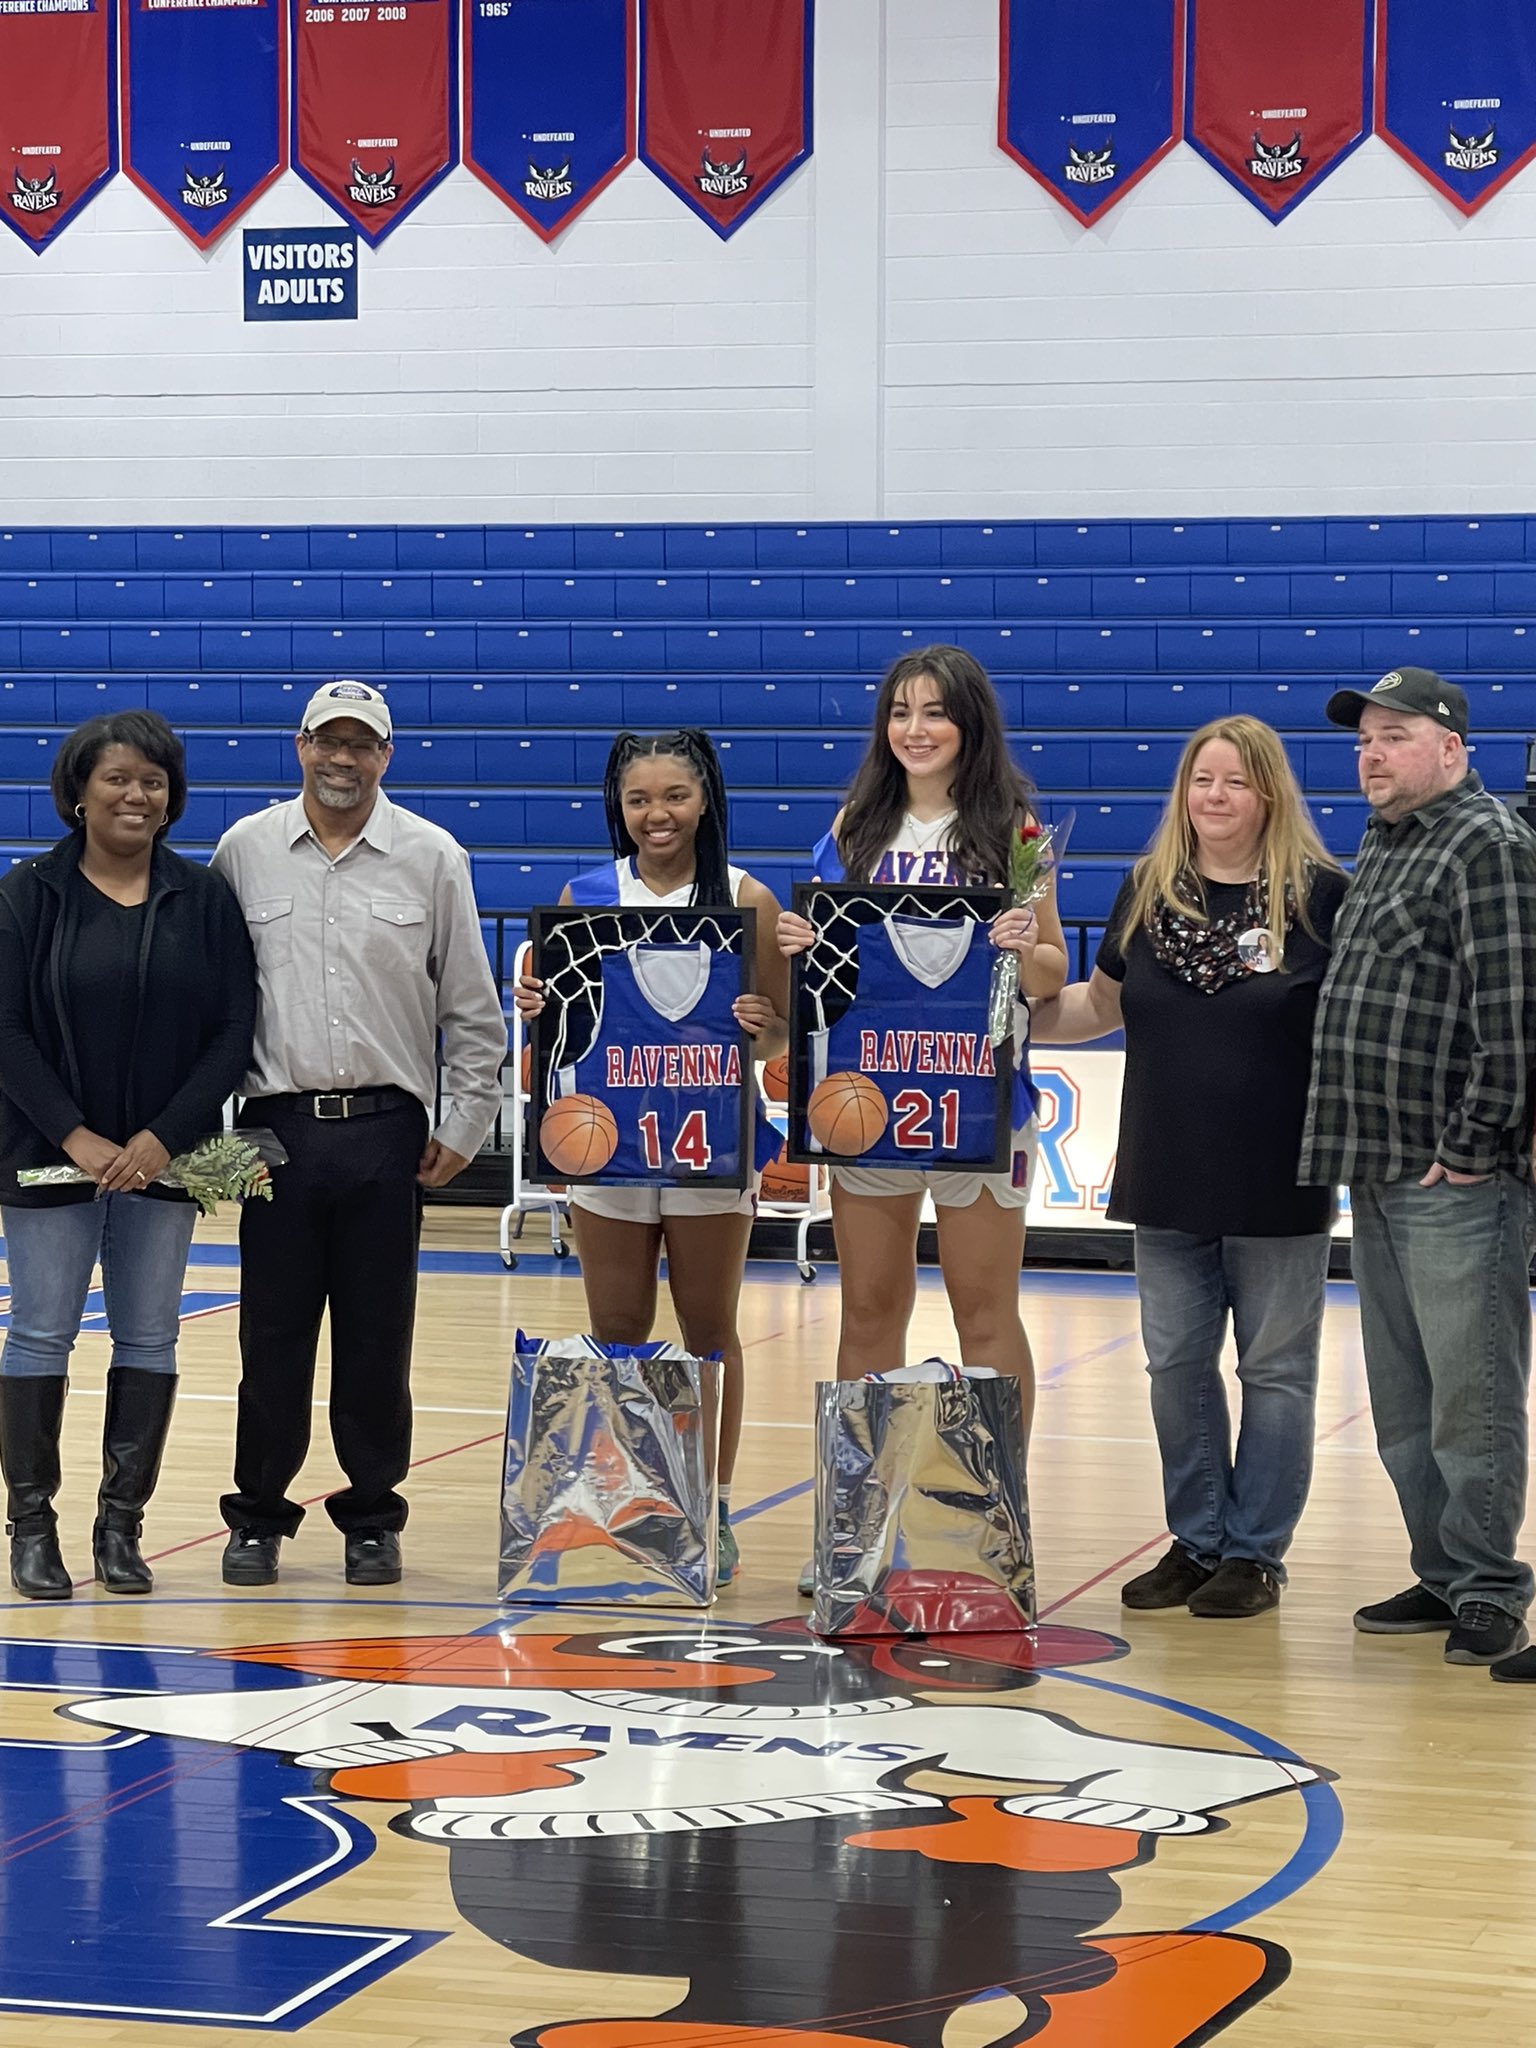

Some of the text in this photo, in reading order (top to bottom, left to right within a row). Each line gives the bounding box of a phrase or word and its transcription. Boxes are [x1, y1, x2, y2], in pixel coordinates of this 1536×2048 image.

[37, 0, 89, 12] CHAMPIONS
[305, 7, 407, 23] 2006 2007 2008
[1251, 159, 1302, 179] RAVENS
[1445, 149, 1497, 169] RAVENS
[1065, 164, 1116, 184] RAVENS
[349, 186, 396, 204] RAVENS
[525, 181, 572, 200] RAVENS
[699, 176, 748, 196] RAVENS
[12, 193, 57, 212] RAVENS
[182, 189, 228, 208] RAVENS
[247, 242, 354, 270] VISITORS
[257, 277, 345, 304] ADULTS
[861, 1029, 997, 1077] RAVENNA
[606, 1044, 742, 1087] RAVENNA
[892, 1088, 960, 1150] 21
[638, 1110, 711, 1171] 14
[412, 1704, 924, 1762] RAVENS
